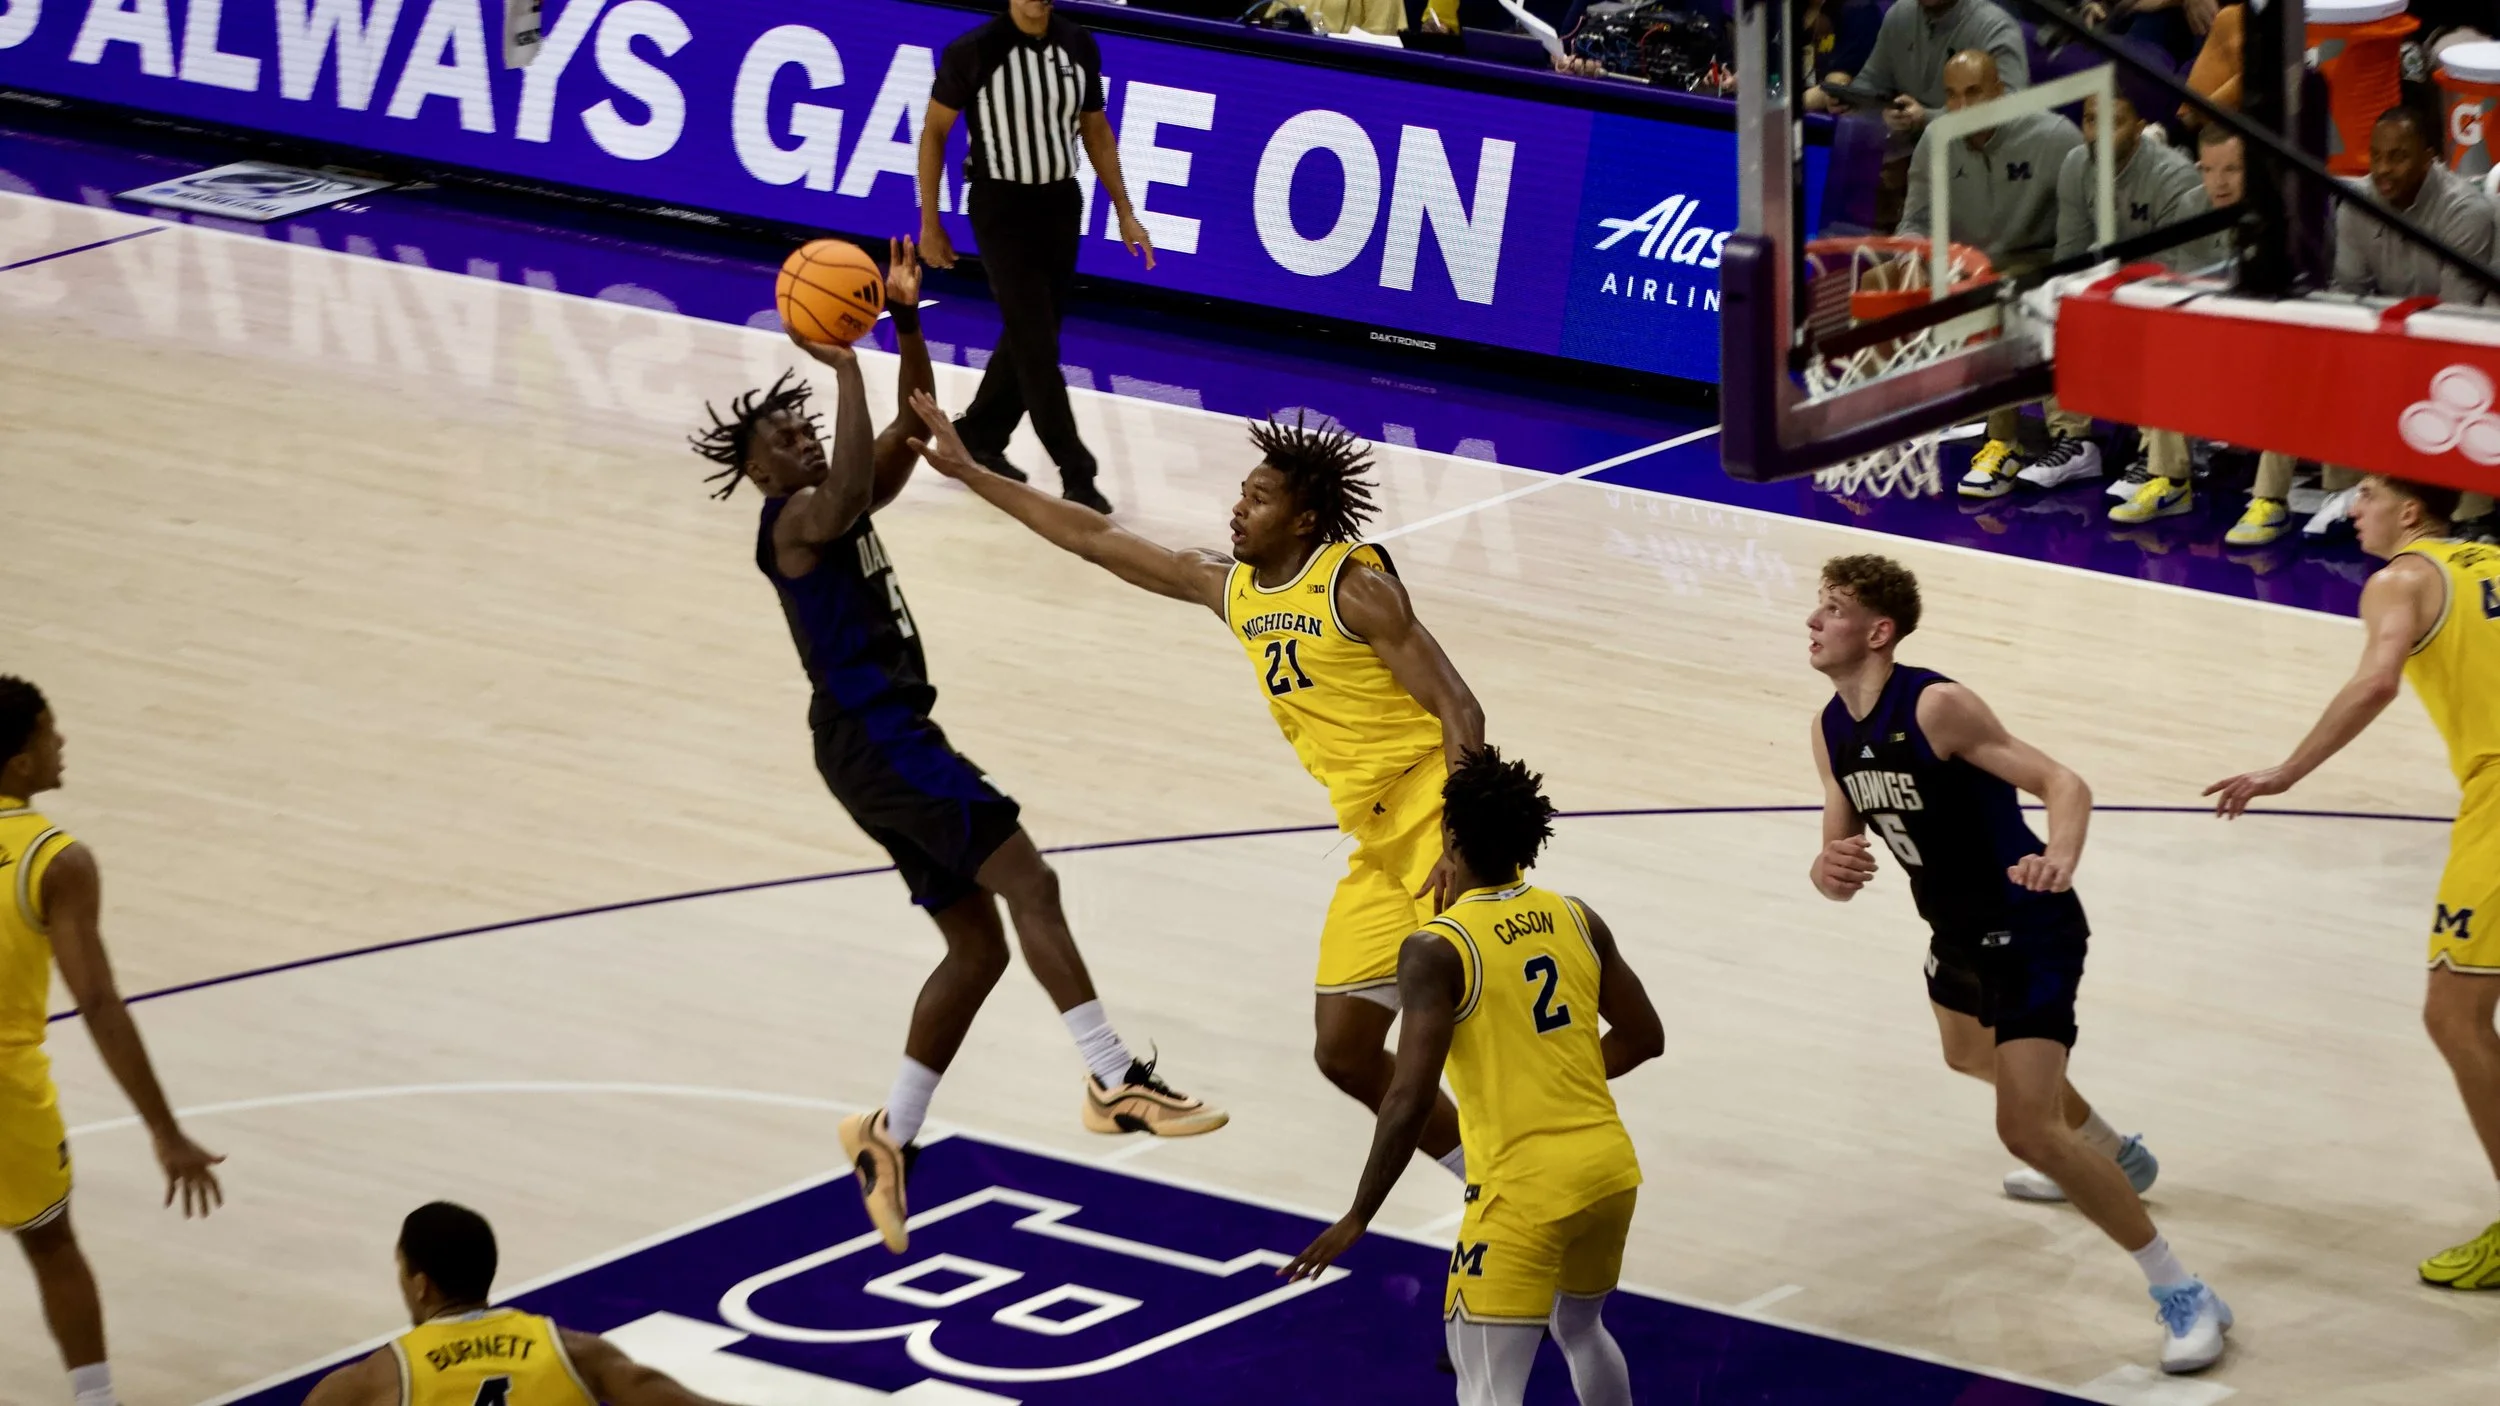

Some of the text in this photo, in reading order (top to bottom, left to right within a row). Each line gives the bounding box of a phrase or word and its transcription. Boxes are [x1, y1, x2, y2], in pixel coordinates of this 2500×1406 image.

[2451, 103, 2484, 146] G
[731, 24, 1216, 254] GAE
[1253, 109, 1516, 305] ON
[1593, 194, 1733, 269] Alas
[1600, 272, 1721, 312] AIRLIN
[1370, 331, 1436, 350] DAKTRONICS
[1241, 611, 1323, 641] MICHIGAN
[1264, 639, 1314, 696] 21
[1843, 770, 1924, 813] DAWGS
[1872, 813, 1923, 867] 6
[1494, 910, 1555, 946] CASON
[2432, 904, 2473, 940] M
[1523, 954, 1571, 1035] 2
[1450, 1240, 1488, 1277] M
[425, 1334, 537, 1373] BURNETT
